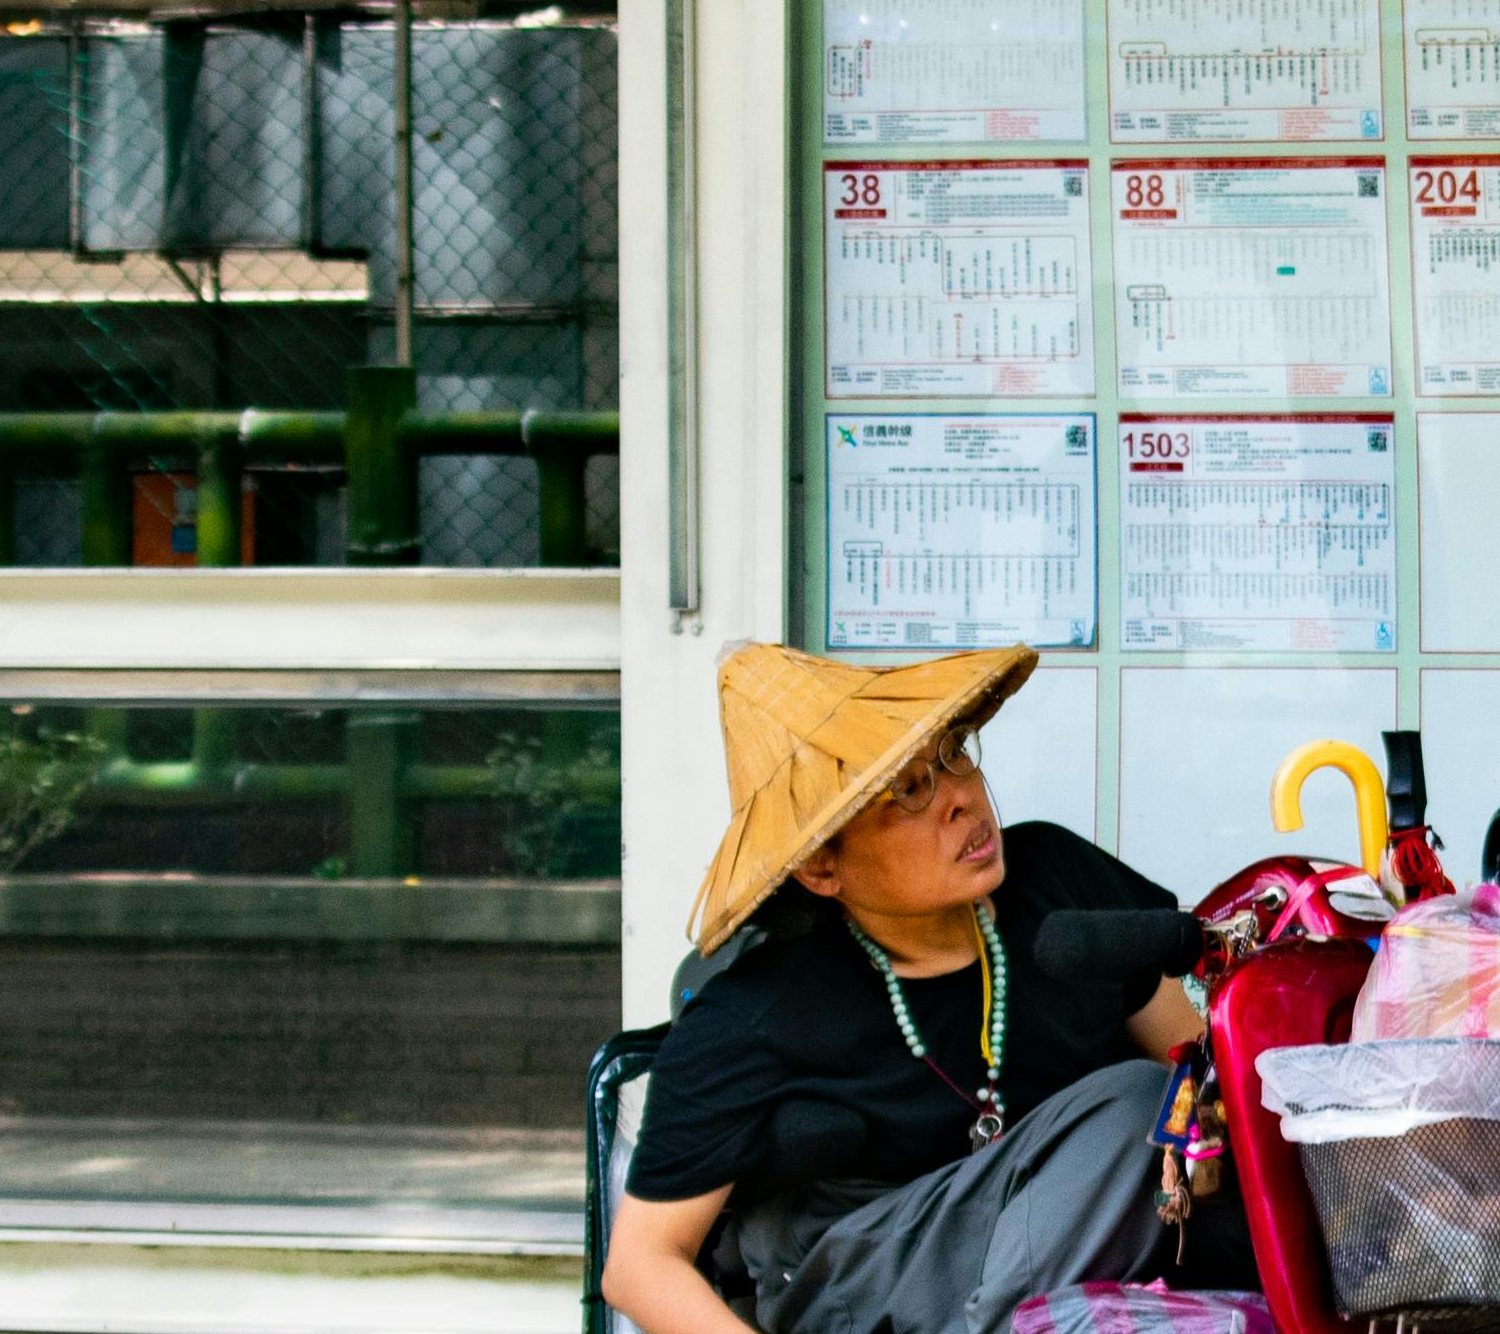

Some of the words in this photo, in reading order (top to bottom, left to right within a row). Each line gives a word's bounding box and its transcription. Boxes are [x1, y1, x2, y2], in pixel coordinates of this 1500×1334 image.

[840, 173, 881, 207] 38
[1126, 173, 1165, 208] 88
[1414, 169, 1481, 204] 204
[1123, 432, 1190, 459] 1503
